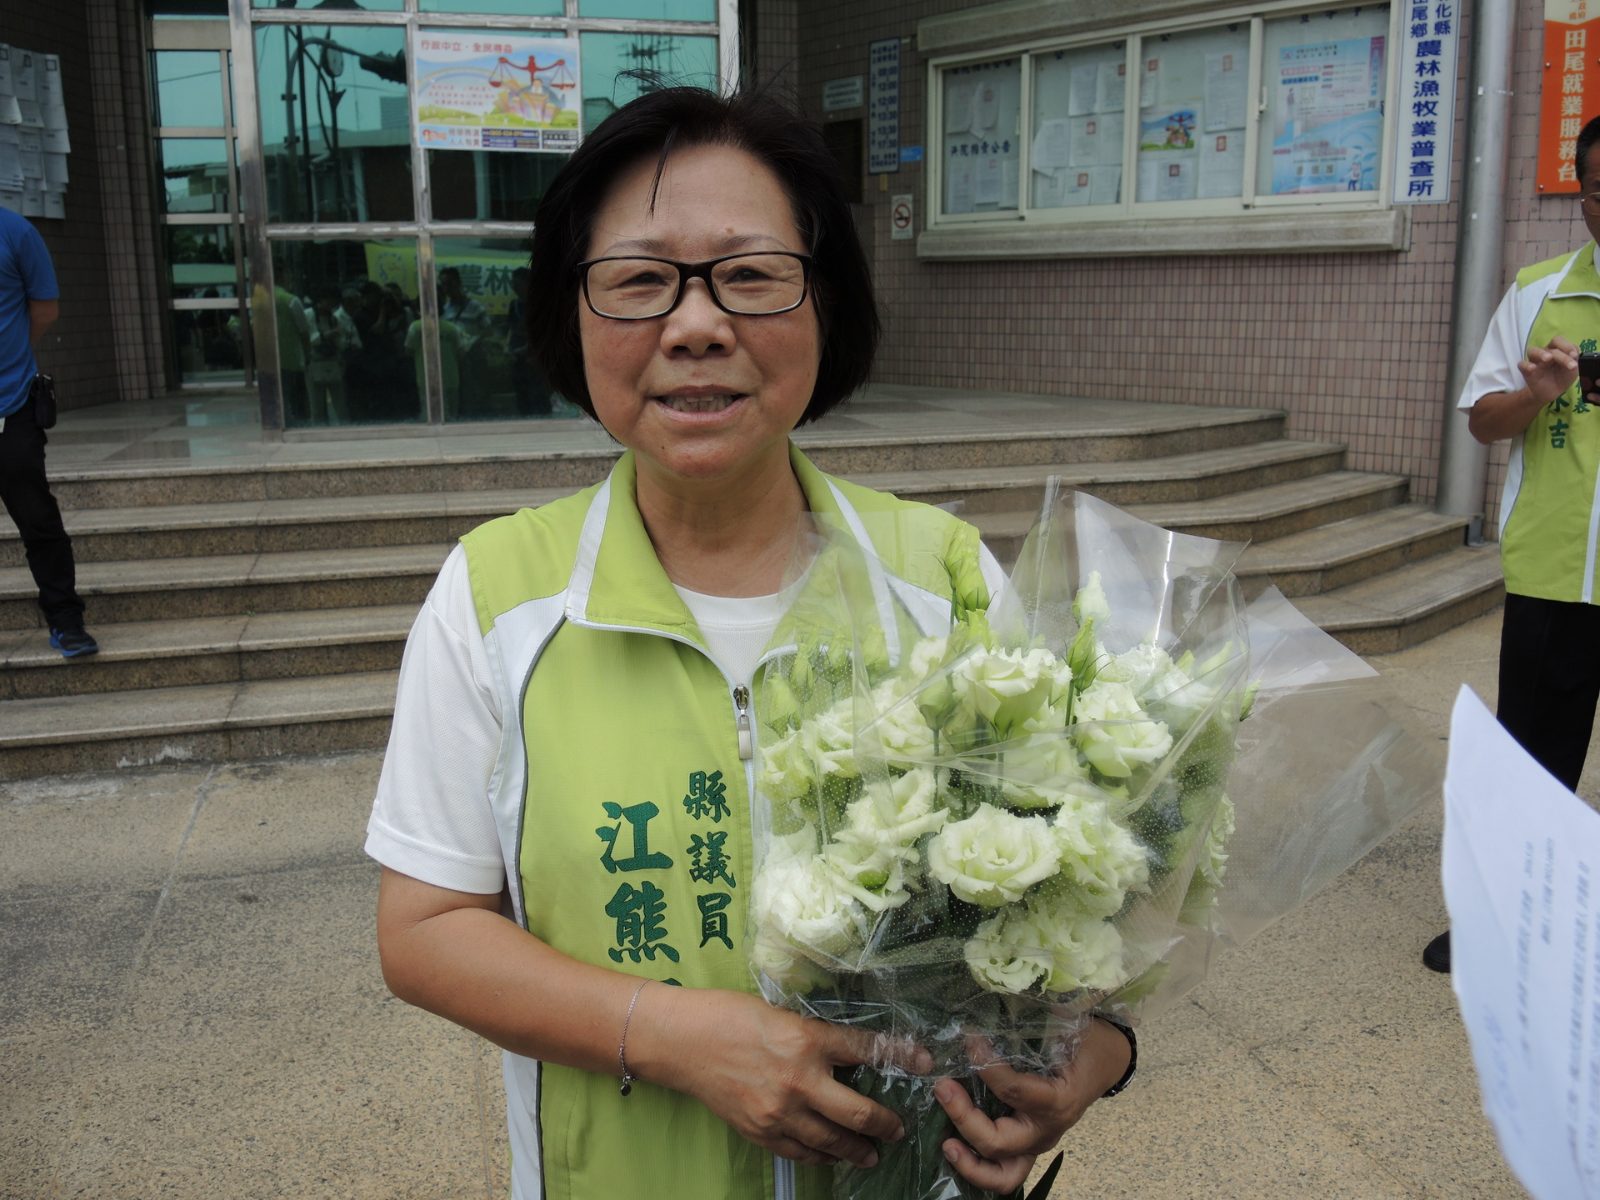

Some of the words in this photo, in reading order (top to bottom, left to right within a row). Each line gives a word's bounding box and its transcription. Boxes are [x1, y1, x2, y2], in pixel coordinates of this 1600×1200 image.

[1433, 0, 1452, 36] 化縣
[1408, 40, 1442, 196] 農林漁牧業普查所
[1558, 29, 1586, 182] 田尾就業服務台
[596, 801, 682, 986] 江熊
[683, 770, 736, 950] 縣議員
